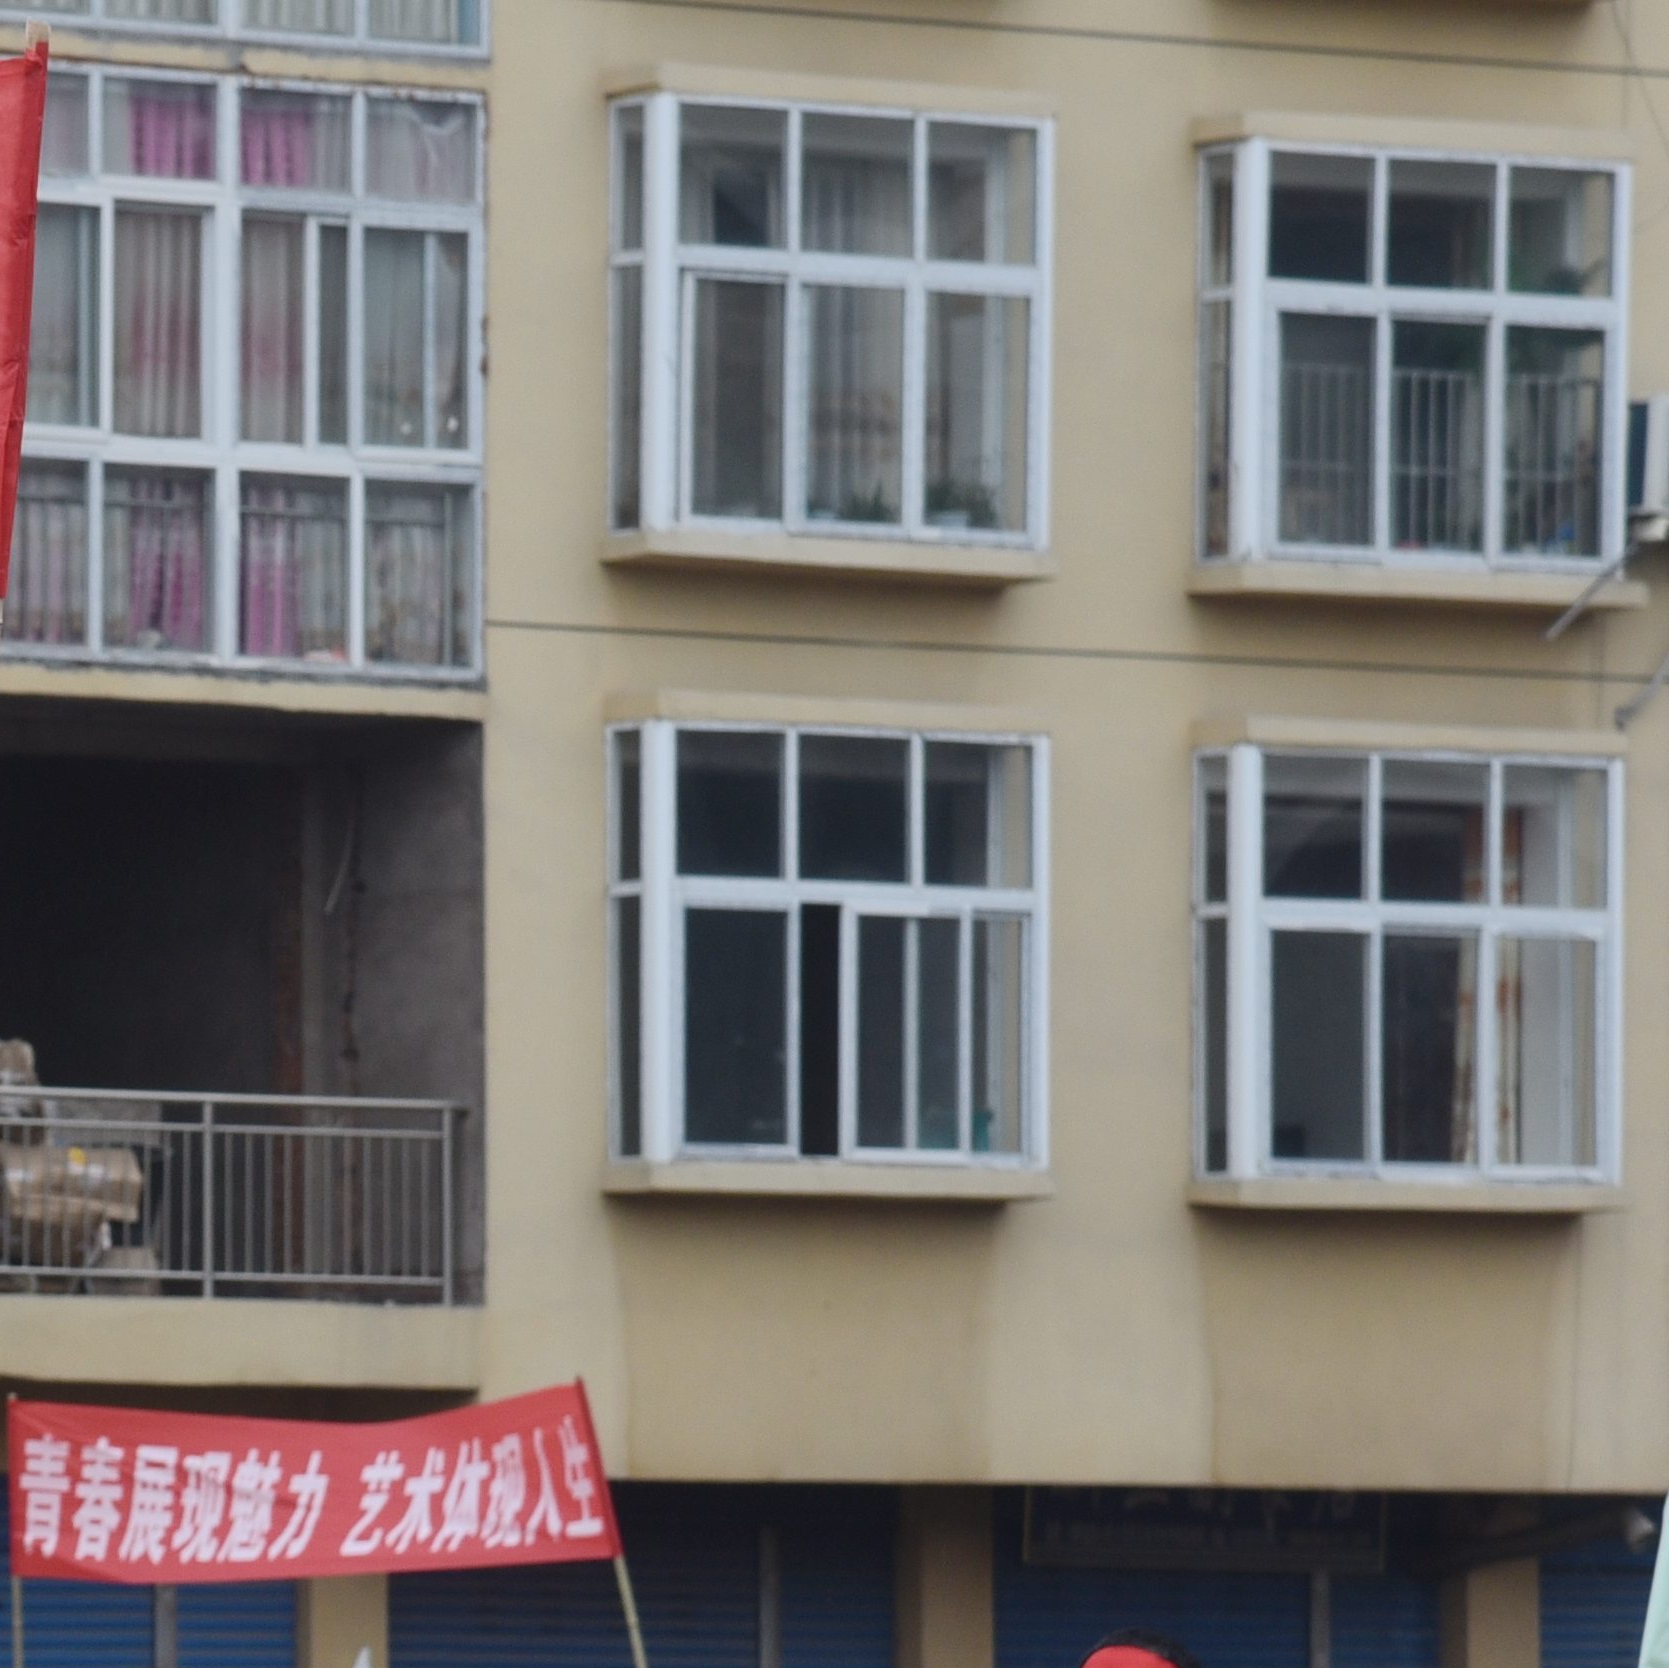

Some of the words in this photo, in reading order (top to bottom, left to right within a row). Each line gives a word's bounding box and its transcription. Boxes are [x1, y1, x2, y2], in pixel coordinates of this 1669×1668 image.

[19, 1434, 328, 1565] 青春展现魅力
[340, 1416, 604, 1556] 艺术体现人生
